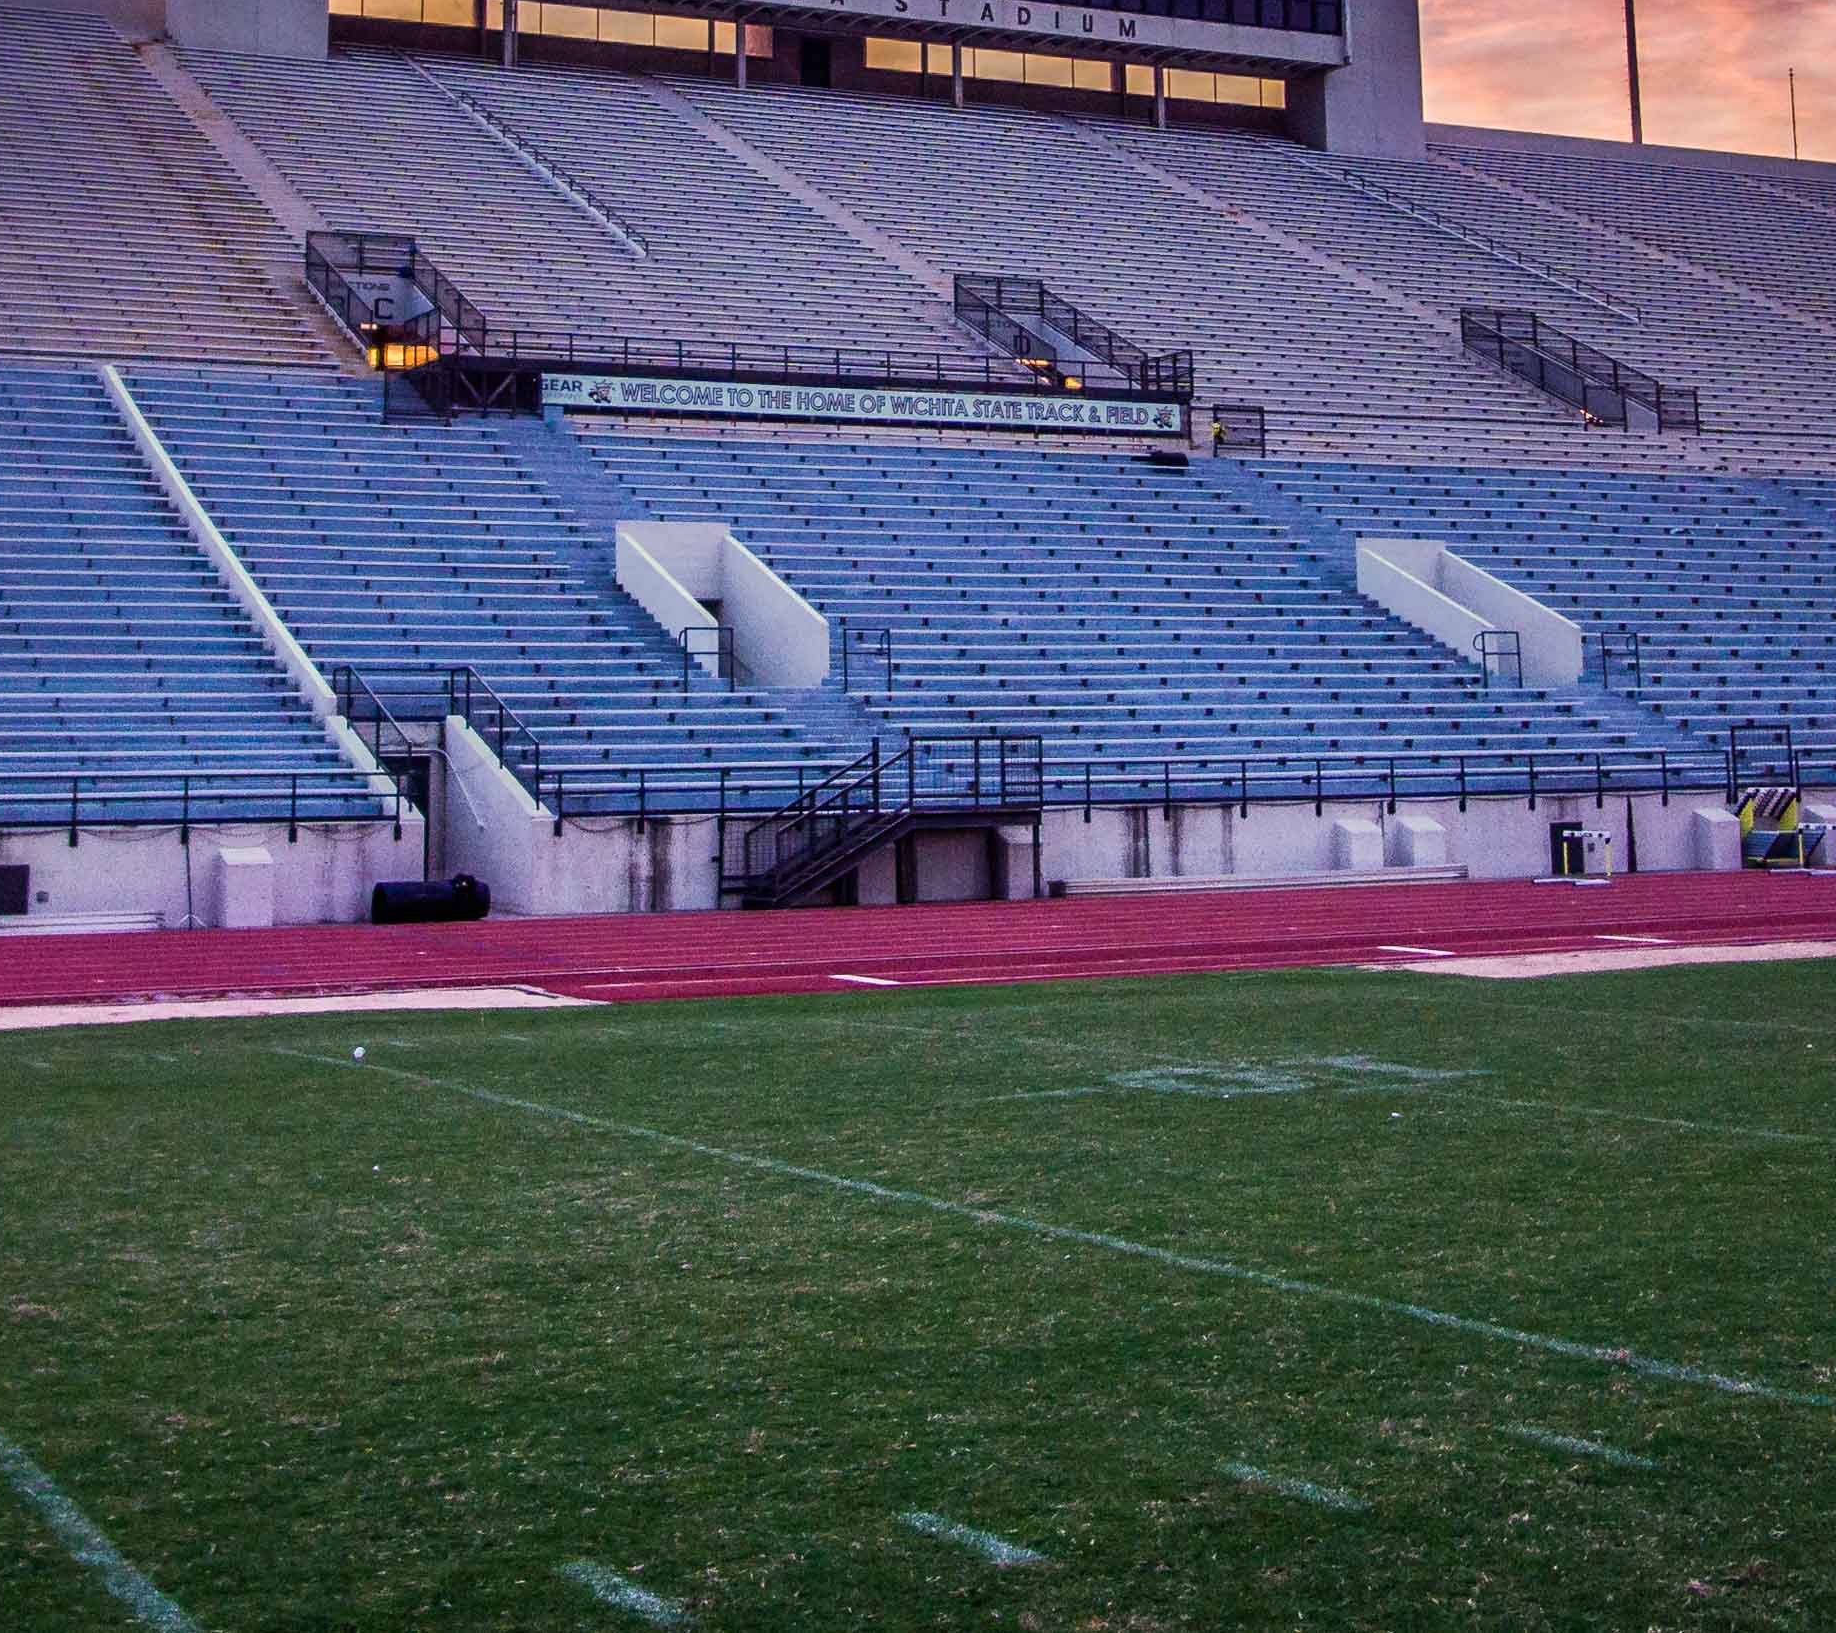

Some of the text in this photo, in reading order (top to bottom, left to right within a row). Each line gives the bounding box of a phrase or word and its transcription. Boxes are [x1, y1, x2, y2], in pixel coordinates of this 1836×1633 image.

[374, 297, 395, 320] C
[620, 381, 1149, 426] WELCOME TO THE HOME OF WICHITA STATE TRACK & FIELD
